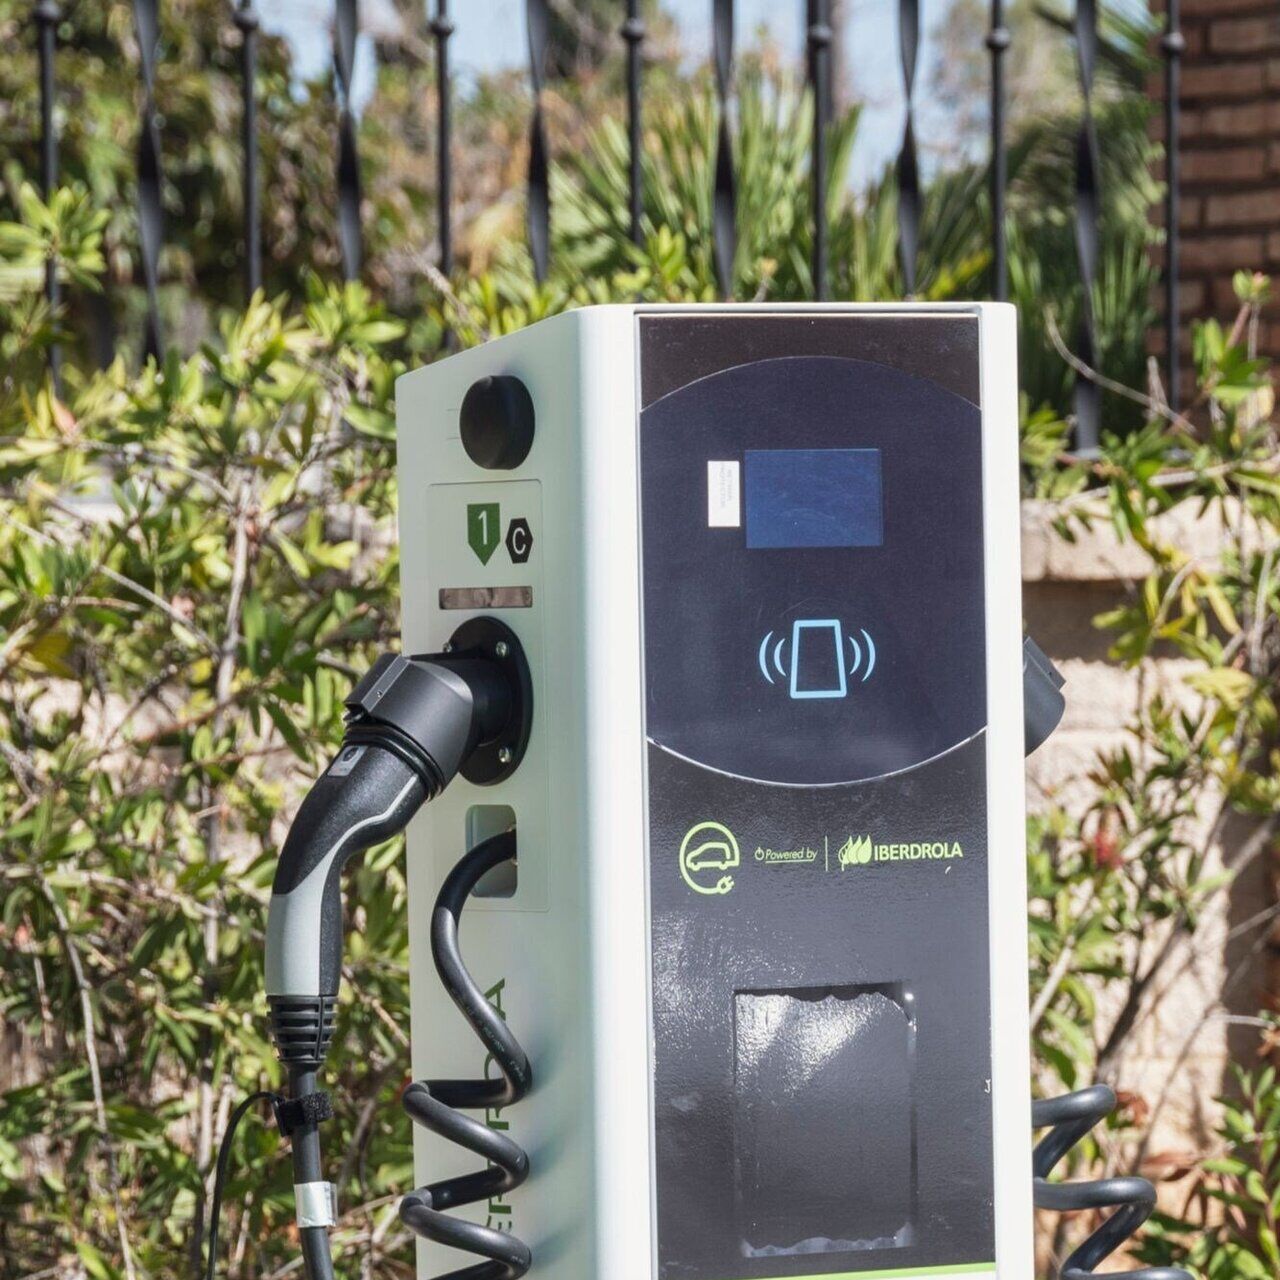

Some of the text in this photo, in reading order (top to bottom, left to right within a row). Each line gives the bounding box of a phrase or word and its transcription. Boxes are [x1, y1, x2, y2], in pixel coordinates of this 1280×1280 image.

[478, 510, 488, 545] 1
[512, 527, 527, 555] C
[765, 846, 819, 862] Powered by
[873, 841, 964, 862] IBERDROLA
